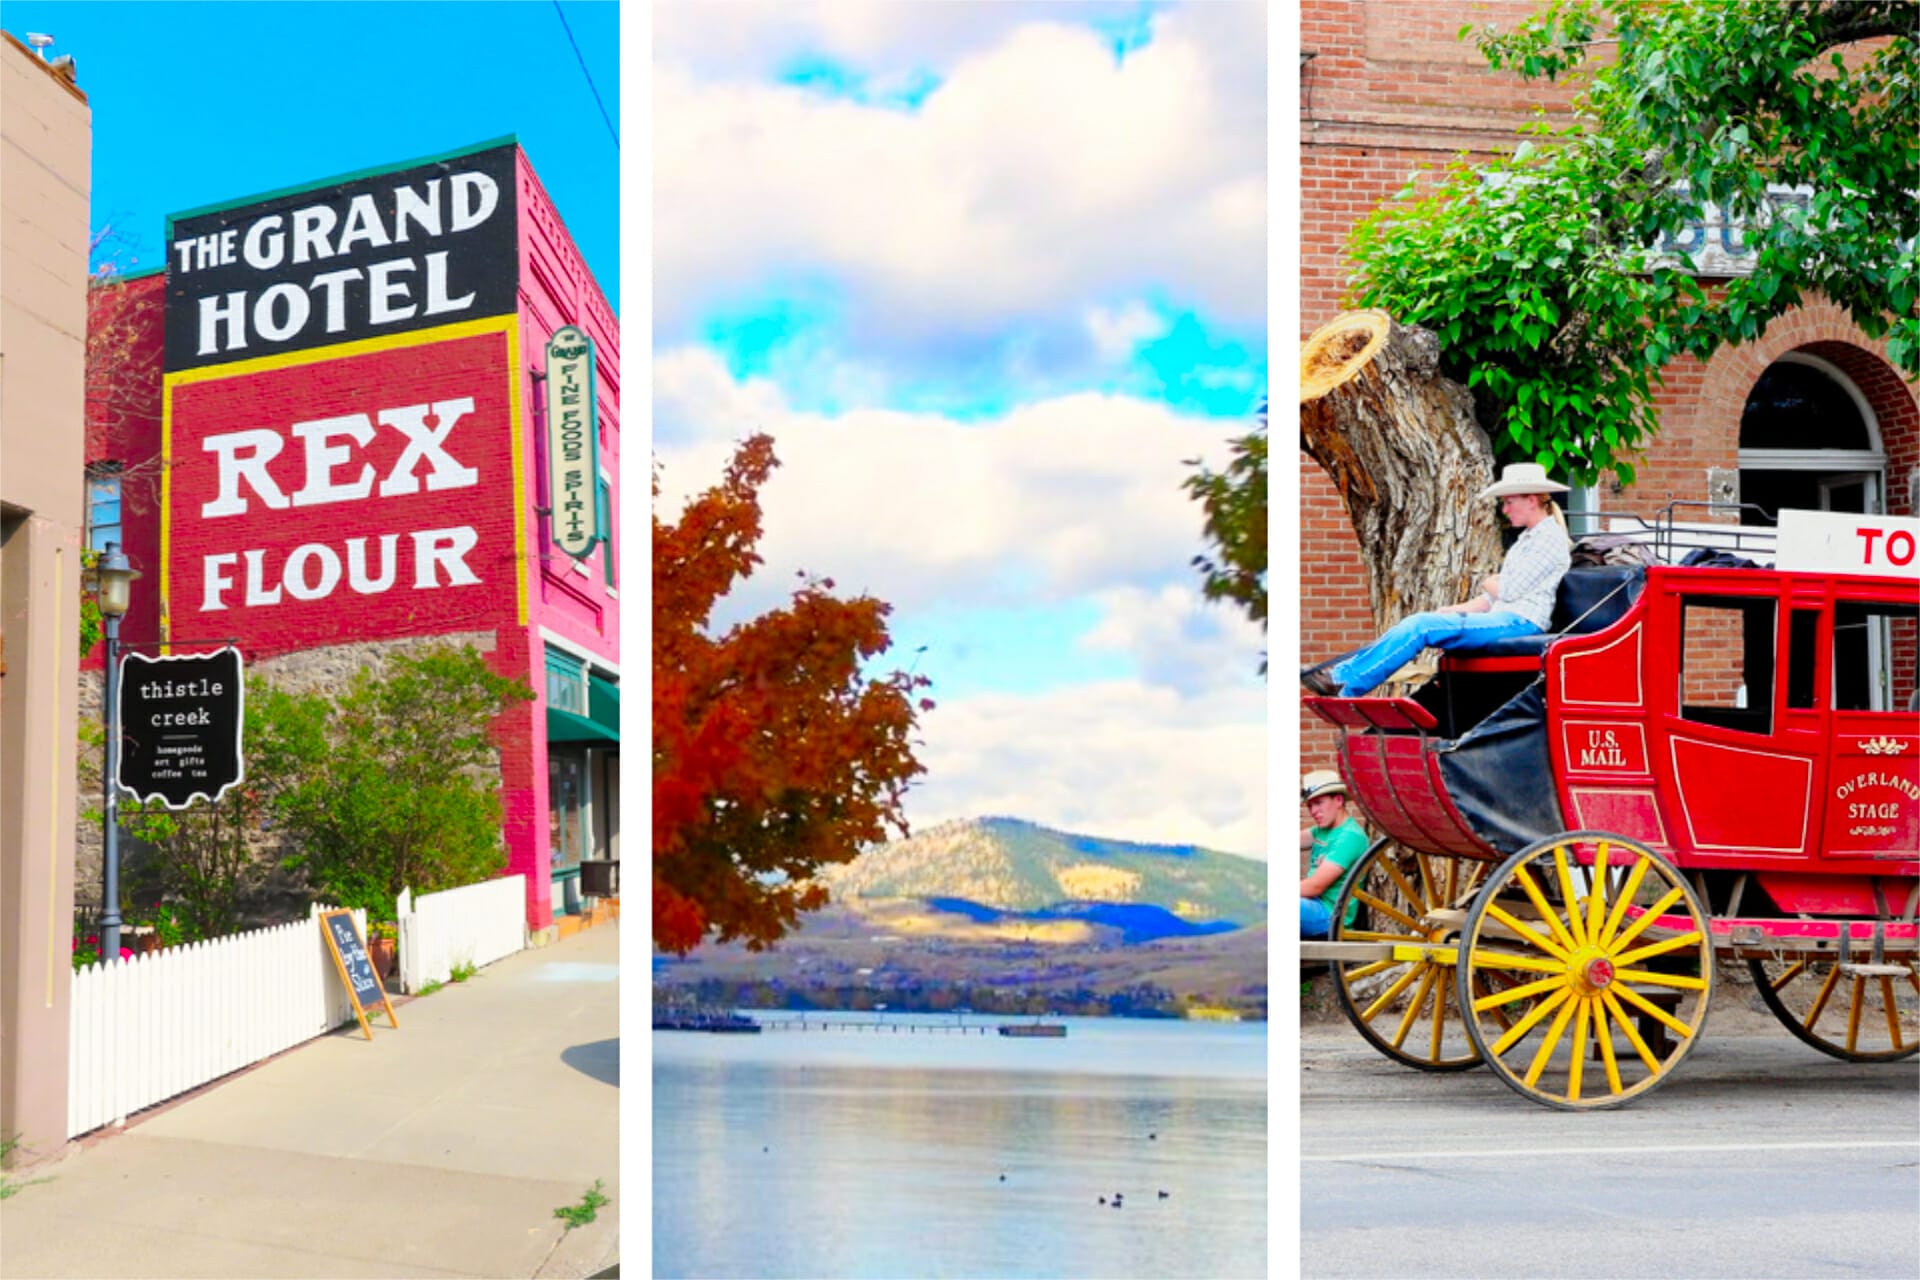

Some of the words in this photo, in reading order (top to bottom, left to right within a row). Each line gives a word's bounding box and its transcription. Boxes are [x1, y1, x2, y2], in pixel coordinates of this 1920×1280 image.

[173, 229, 240, 273] THE
[242, 170, 500, 270] GRAND
[196, 250, 477, 357] HOTEL
[561, 363, 580, 405] FINE
[561, 410, 583, 461] FOODS
[201, 396, 479, 519] REX
[565, 470, 584, 541] SPIRITS
[1856, 527, 1917, 567] TO
[199, 525, 484, 613] FLOUR
[140, 678, 224, 699] thistle
[151, 707, 211, 726] creek
[1587, 729, 1620, 749] U.S.
[151, 769, 183, 779] coffee
[154, 758, 170, 766] art
[179, 757, 205, 768] gifts
[1580, 748, 1628, 767] MAIL
[1836, 771, 1920, 800] OVERLAND
[1847, 802, 1900, 819] STAGE
